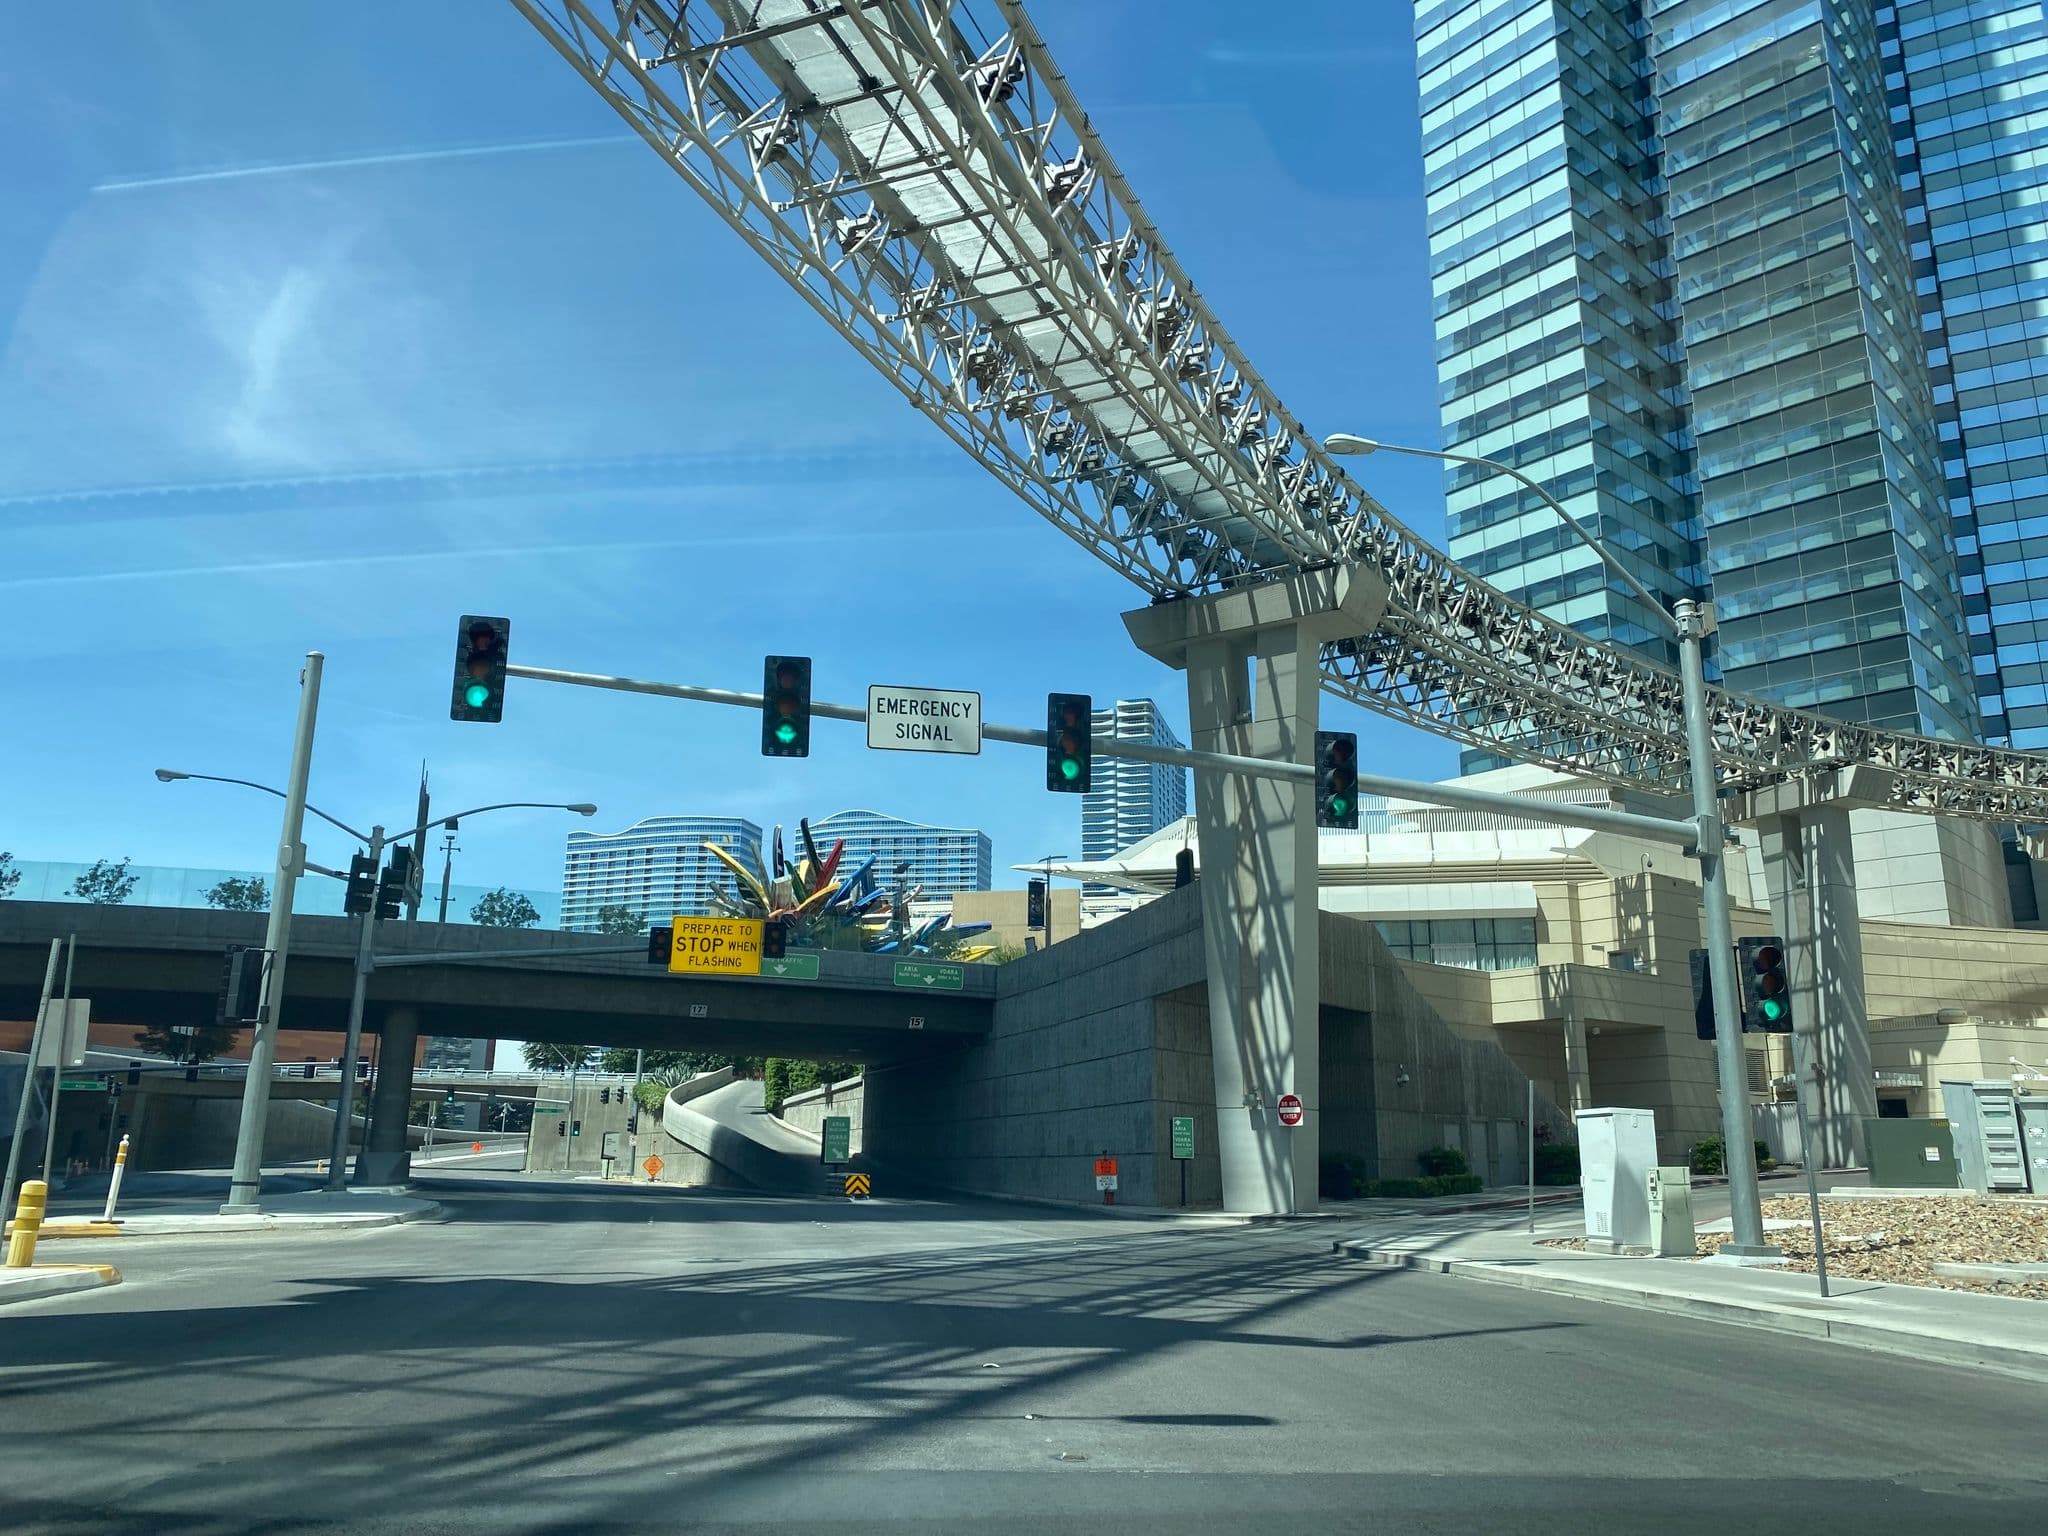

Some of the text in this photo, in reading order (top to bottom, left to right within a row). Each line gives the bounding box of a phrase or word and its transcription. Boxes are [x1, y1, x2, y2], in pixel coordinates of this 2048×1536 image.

[877, 697, 972, 718] EMERGENCY
[896, 723, 953, 741] SIGNAL
[683, 923, 752, 936] PREPARE TO
[676, 936, 757, 953] STOP WHEN
[689, 956, 742, 967] FLASHING
